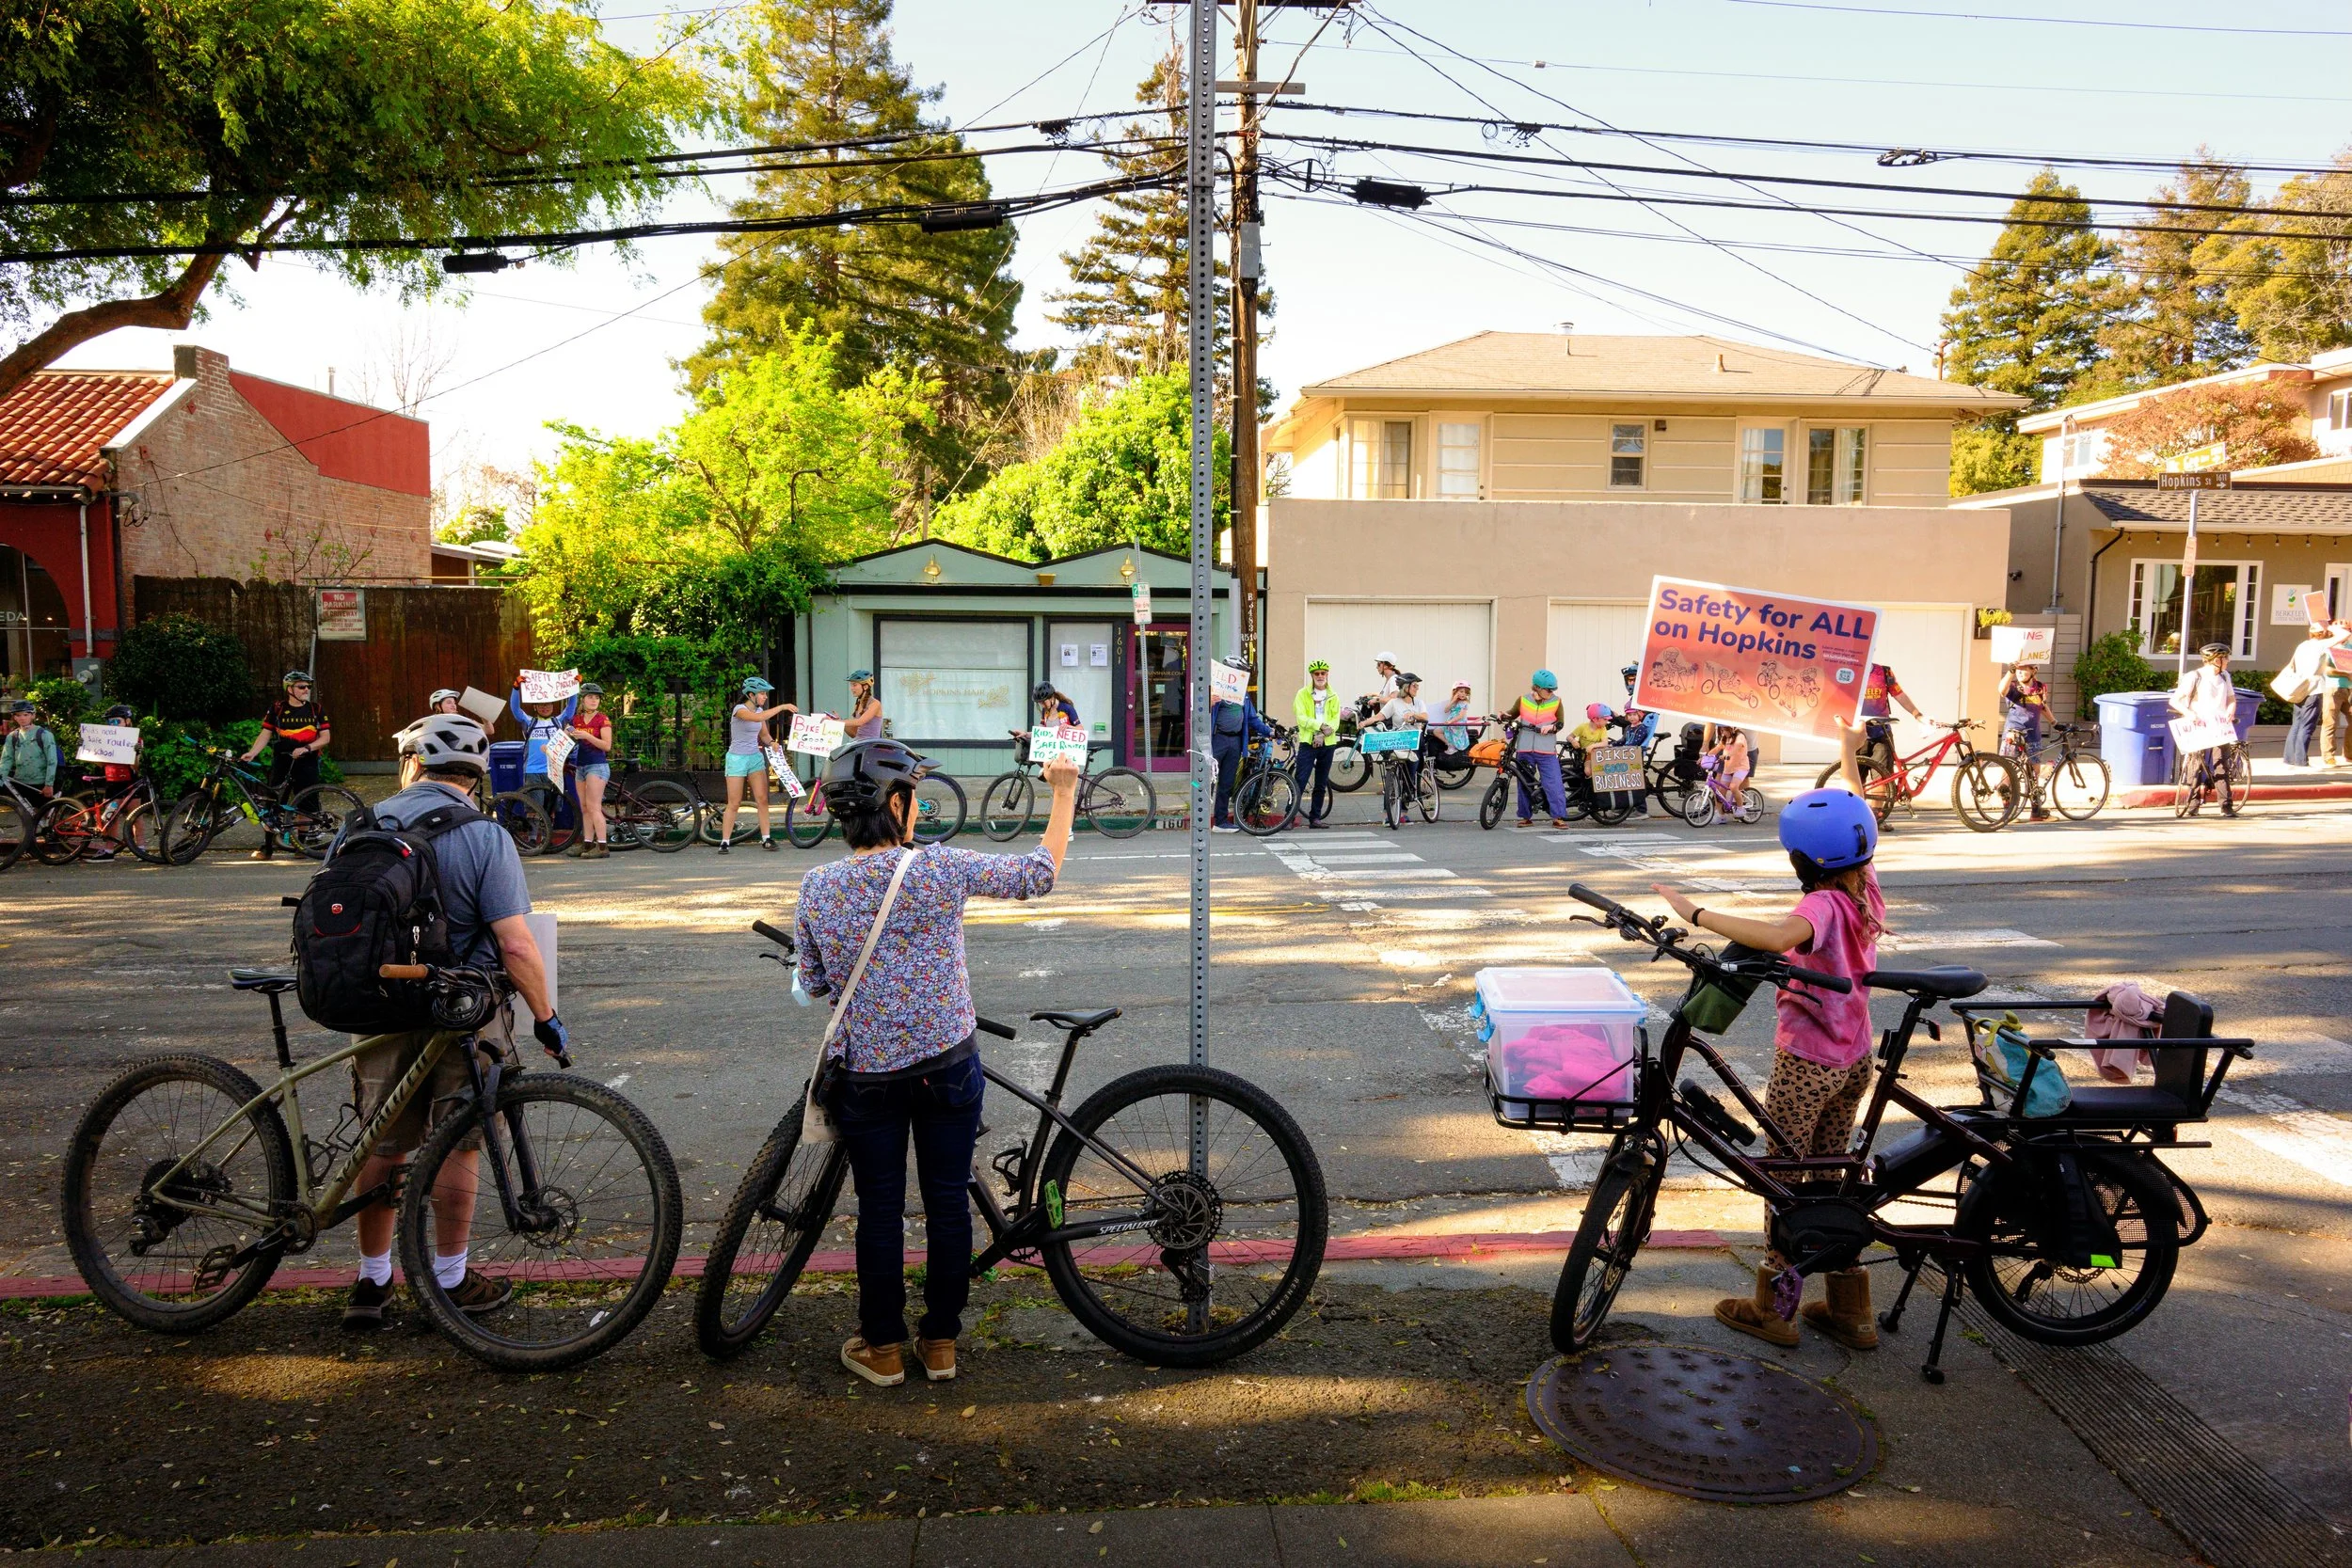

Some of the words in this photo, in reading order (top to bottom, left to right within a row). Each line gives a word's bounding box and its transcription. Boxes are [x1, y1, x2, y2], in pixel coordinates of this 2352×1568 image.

[2161, 473, 2201, 489] Hopkins
[1133, 585, 1138, 597] 2
[1659, 589, 1751, 626] Safety
[1759, 604, 1803, 628] for
[1809, 611, 1869, 640] ALL
[1655, 620, 1688, 640] on
[1698, 621, 1817, 659] Hopkins
[2019, 648, 2051, 662] LANES
[523, 670, 551, 684] SAFETY
[557, 671, 573, 682] FOR
[525, 683, 543, 692] KIDS
[923, 688, 961, 696] HOPKINS
[963, 688, 986, 696] HAIR
[530, 690, 549, 701] FOR
[1703, 705, 1719, 714] ALL
[1720, 708, 1754, 721] Abilities
[1766, 717, 1782, 725] ALL
[1033, 727, 1054, 738] KIDS
[1056, 729, 1087, 743] NEED
[1035, 739, 1057, 750] SAFE
[1033, 751, 1045, 759] TO
[1596, 748, 1636, 763] BIKES
[1604, 763, 1629, 774] GOOD
[1595, 772, 1642, 791] BUSINESS
[1099, 1220, 1158, 1234] SPECIALIZED
[1265, 1277, 1299, 1321] RENEGADE
